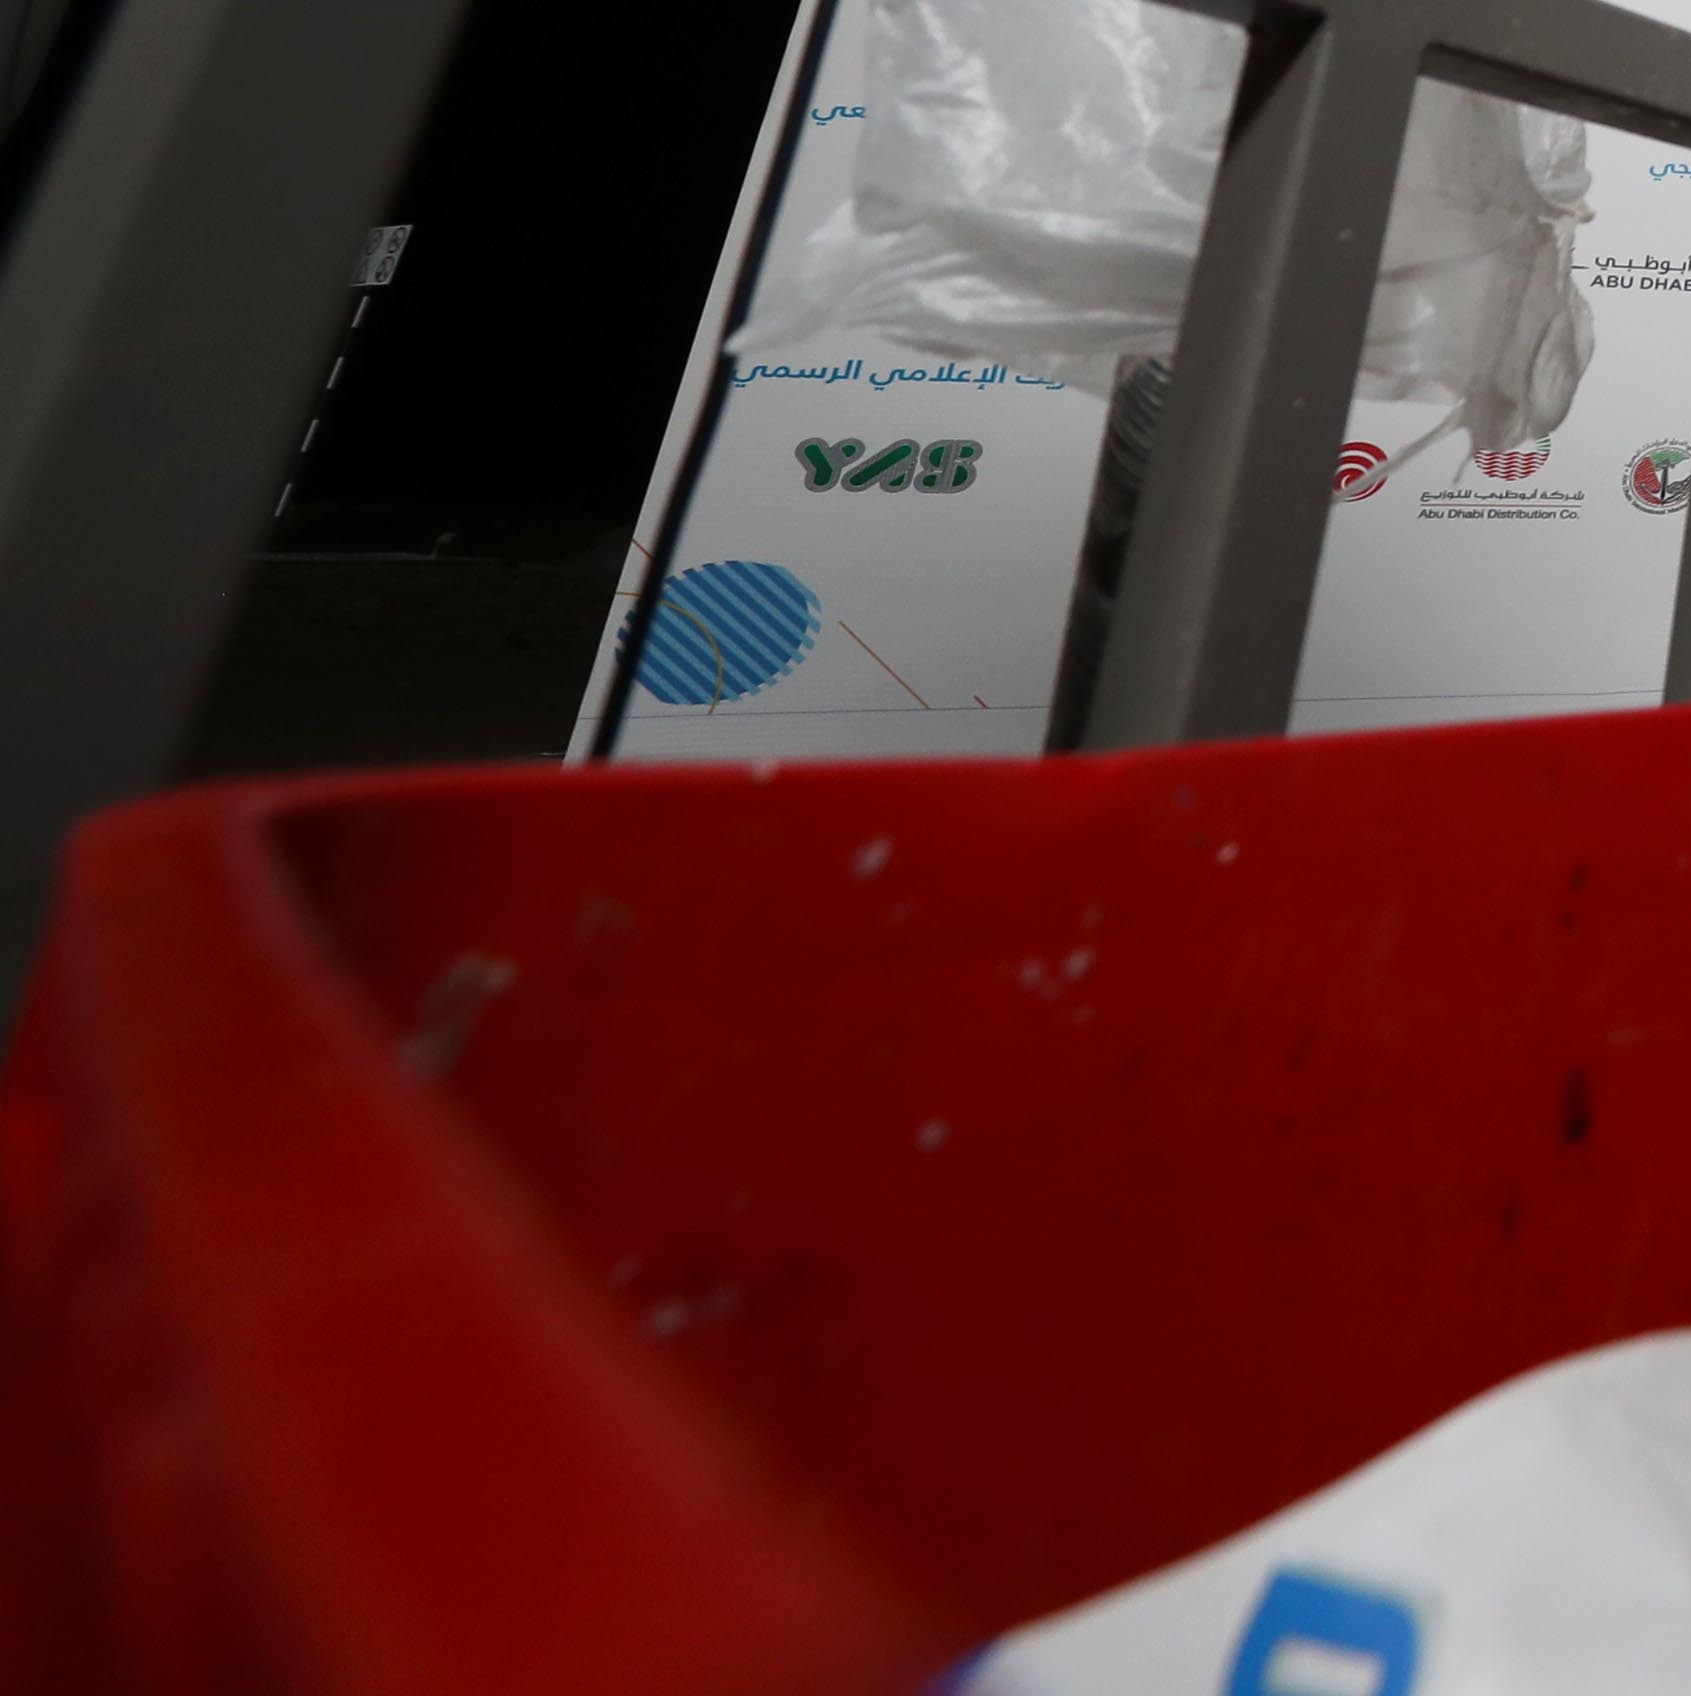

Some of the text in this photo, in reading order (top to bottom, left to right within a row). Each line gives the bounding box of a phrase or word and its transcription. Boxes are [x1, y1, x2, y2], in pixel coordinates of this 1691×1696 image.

[1589, 274, 1634, 289] ABU
[730, 358, 863, 388] الرسمي
[868, 361, 1009, 392] الإعلامي
[1417, 508, 1581, 521] Abu Dhabi Distribution Co.
